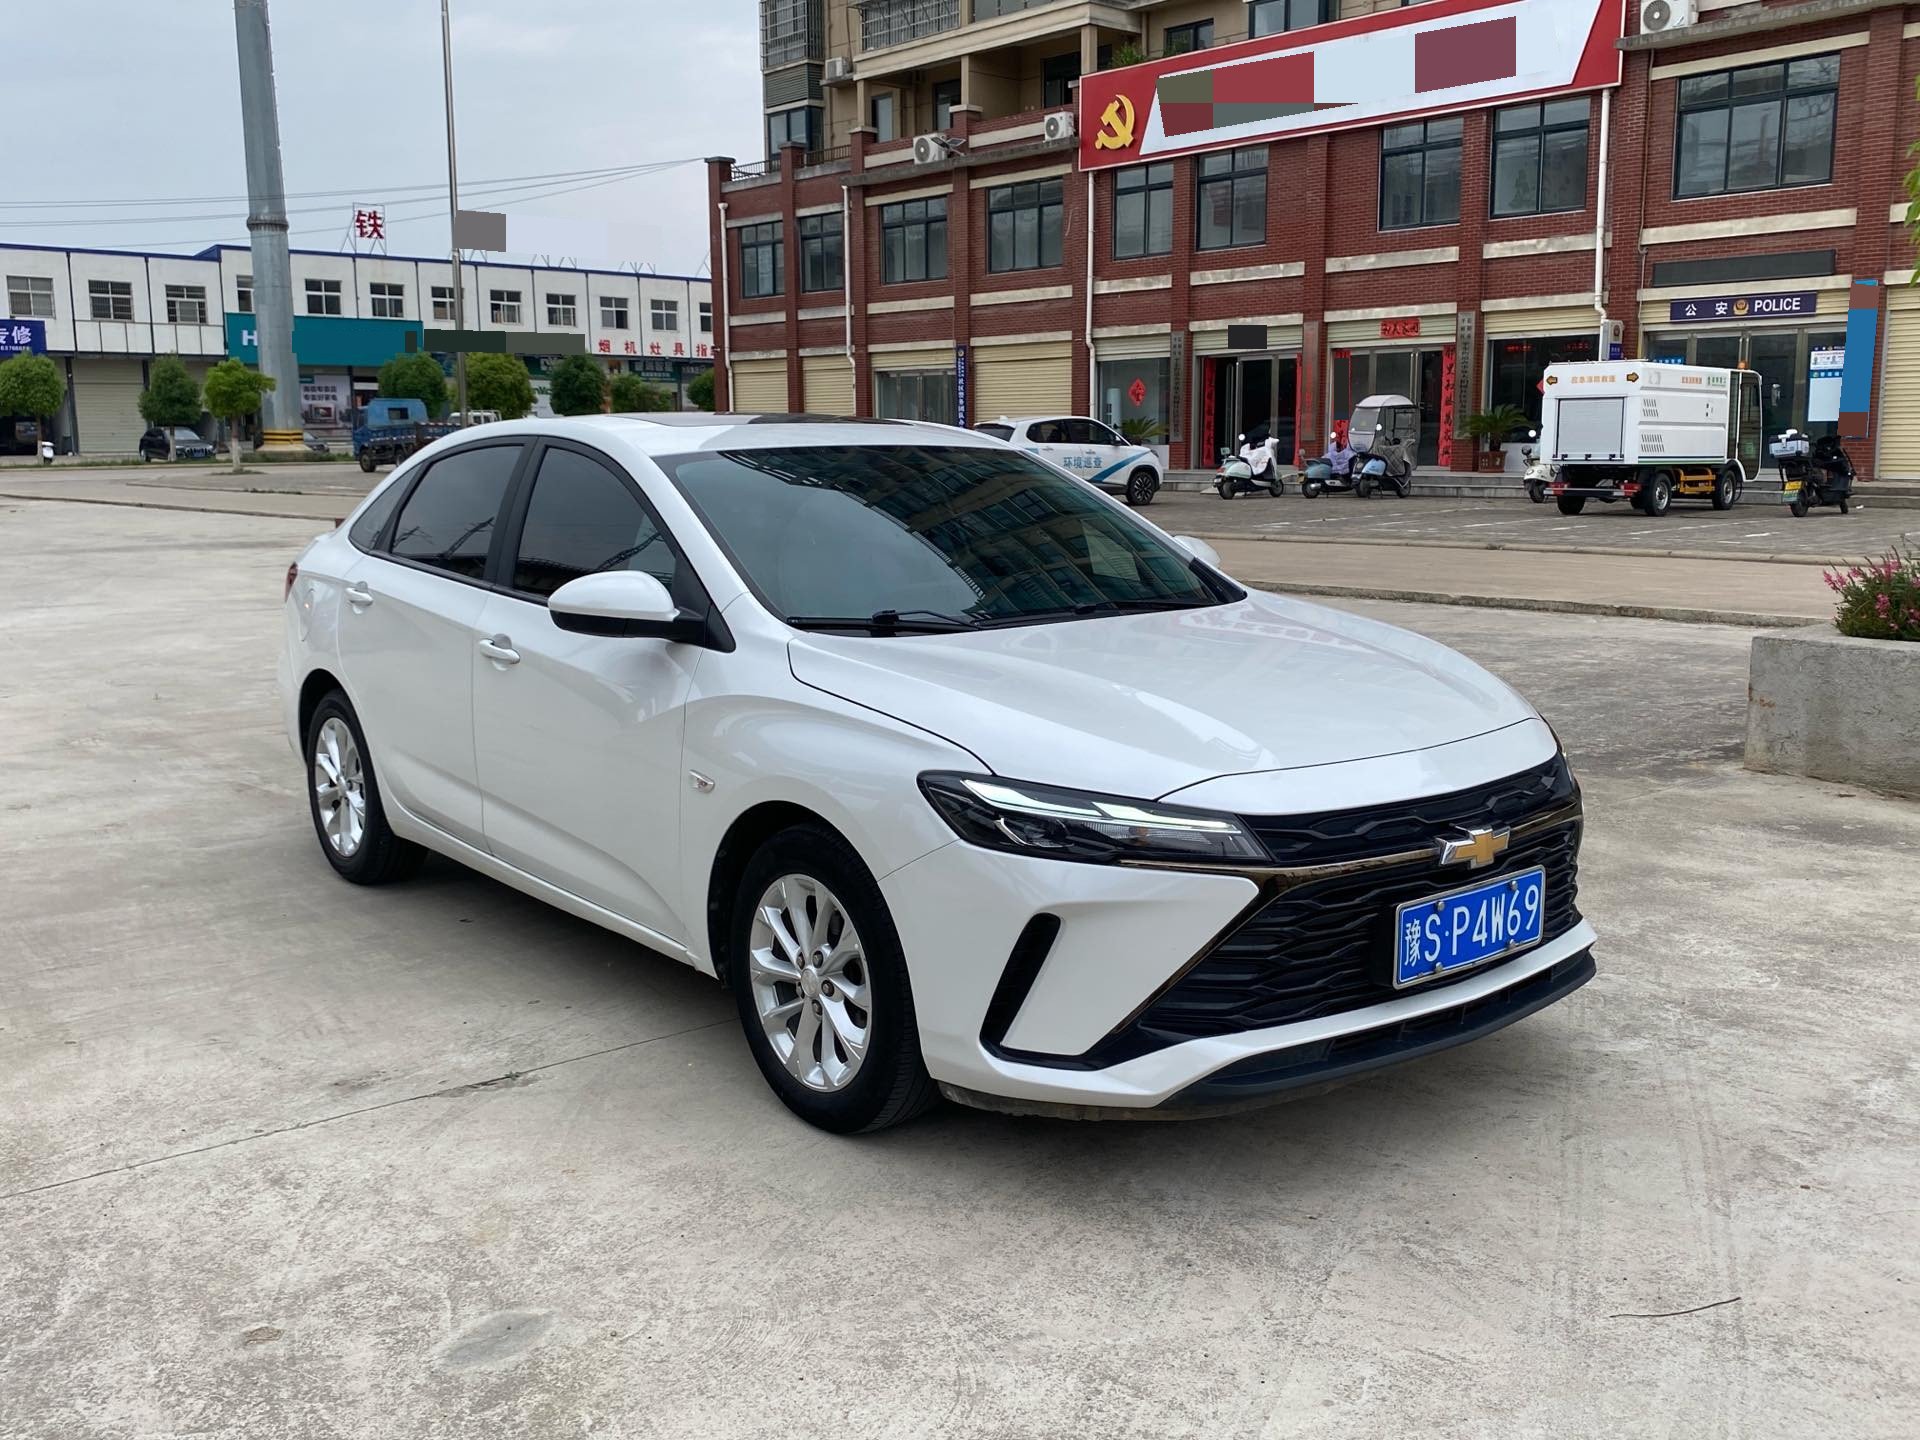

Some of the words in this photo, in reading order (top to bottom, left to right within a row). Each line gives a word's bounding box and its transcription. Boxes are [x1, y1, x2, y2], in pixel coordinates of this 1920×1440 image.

[355, 210, 384, 239] 铁
[1685, 301, 1728, 316] 公安
[1754, 298, 1801, 312] POLICE
[1063, 456, 1102, 468] 环境巡查
[1404, 884, 1539, 967] 豫S·P4W69
